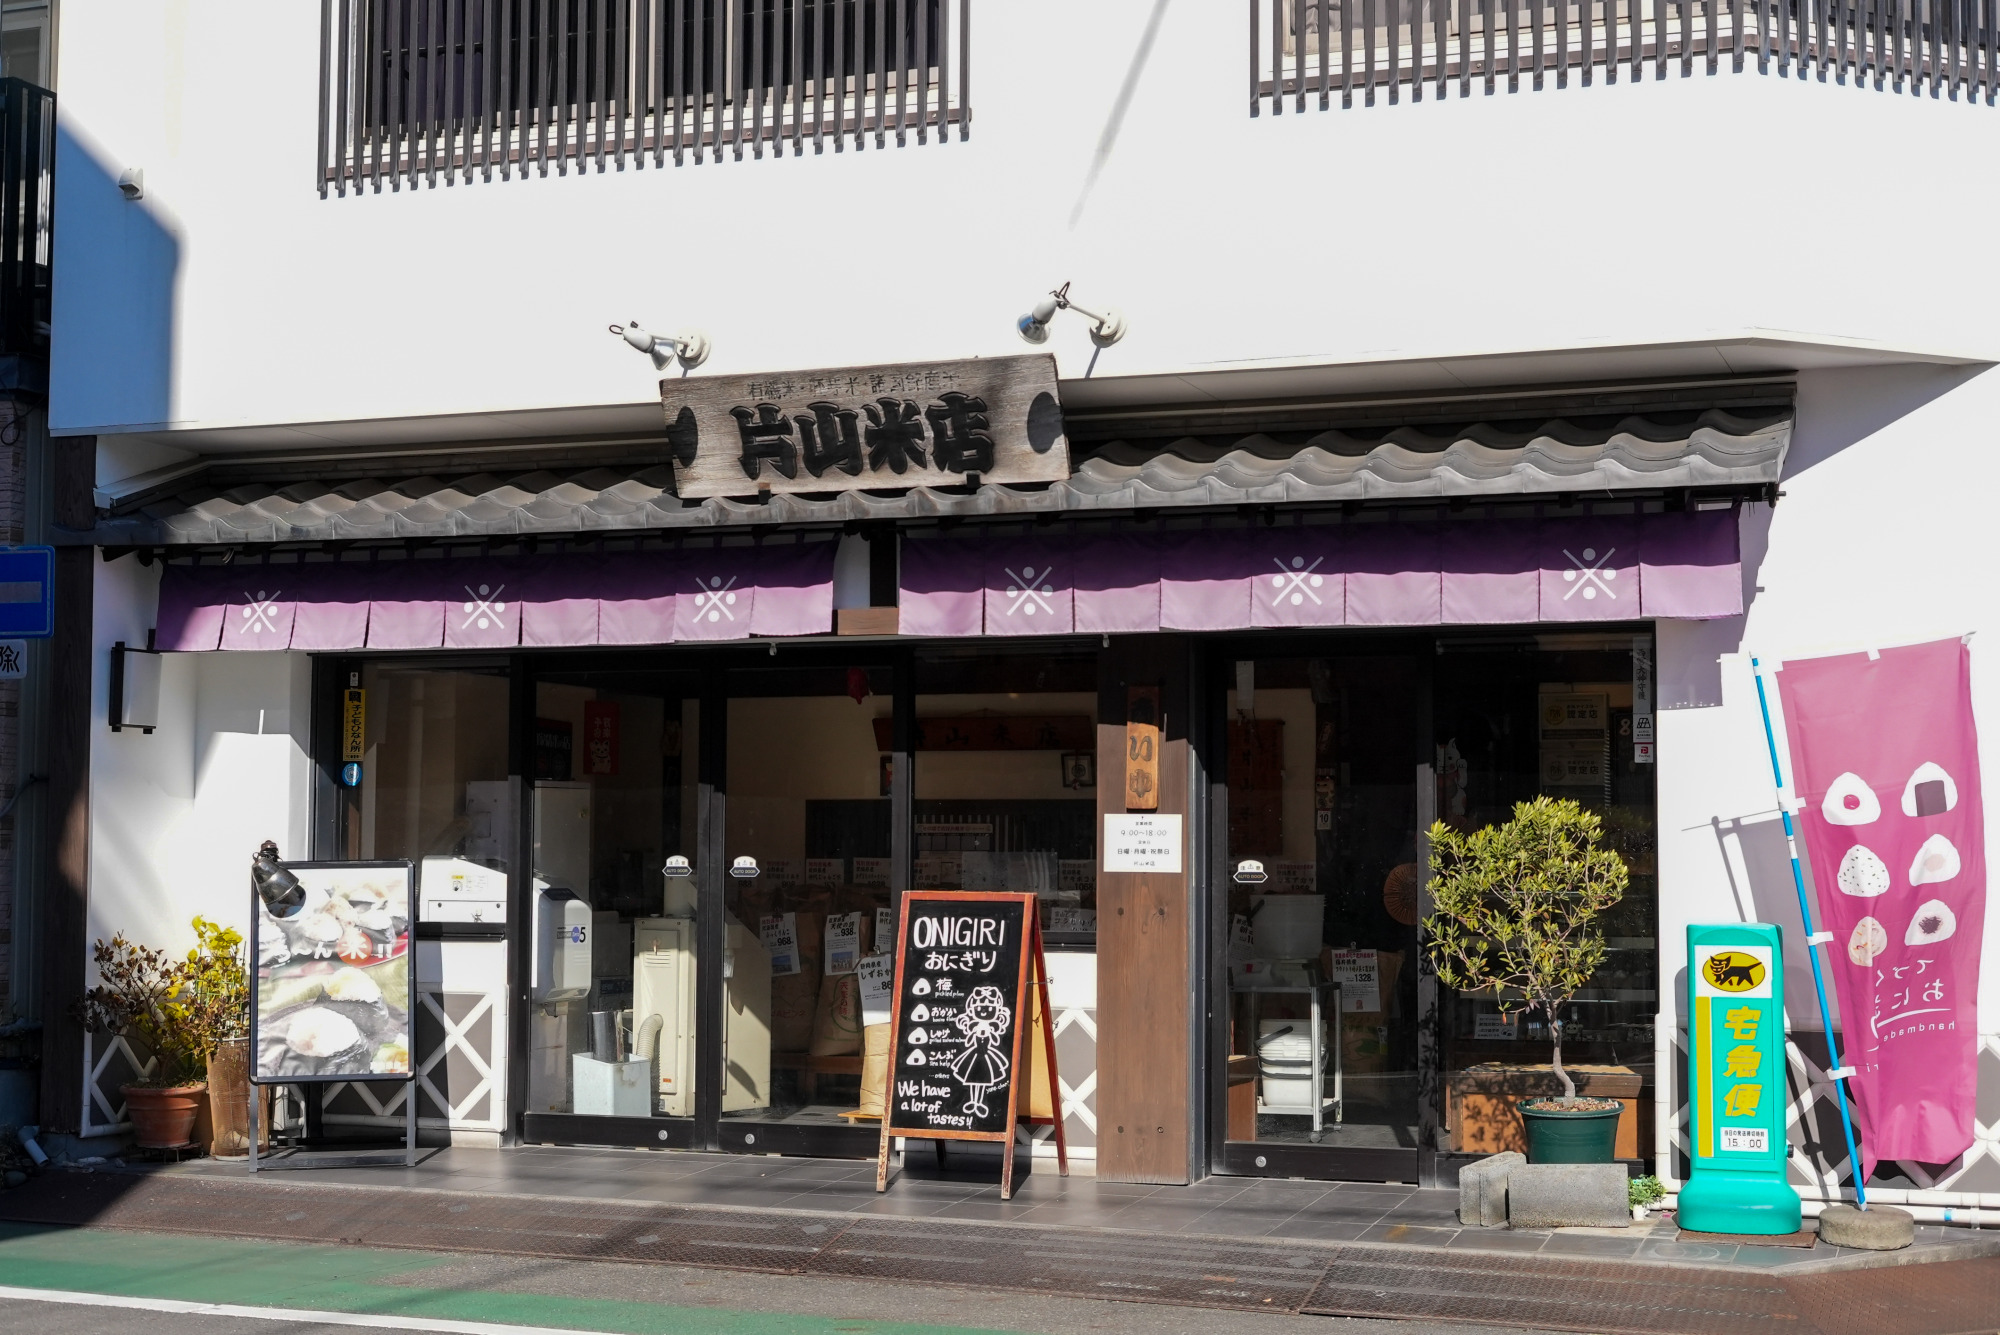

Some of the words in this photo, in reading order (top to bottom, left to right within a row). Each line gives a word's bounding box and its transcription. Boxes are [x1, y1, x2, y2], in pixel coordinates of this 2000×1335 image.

[729, 391, 995, 480] 片山米店
[0, 645, 20, 673] 除く
[350, 704, 362, 752] 子どもひなん所
[579, 926, 586, 943] 5
[841, 928, 854, 937] 938
[913, 916, 1005, 948] ONIGIRI
[777, 936, 792, 947] 968
[924, 950, 998, 973] おにぎり
[935, 977, 953, 991] 梅
[1354, 973, 1372, 983] 1328
[931, 1006, 957, 1017] おかか
[929, 1049, 957, 1061] こんぶ
[1722, 1005, 1763, 1118] 宅急便
[897, 1079, 920, 1098] We
[921, 1079, 951, 1098] have
[900, 1101, 910, 1110] a
[911, 1098, 928, 1112] lot
[927, 1100, 942, 1113] of
